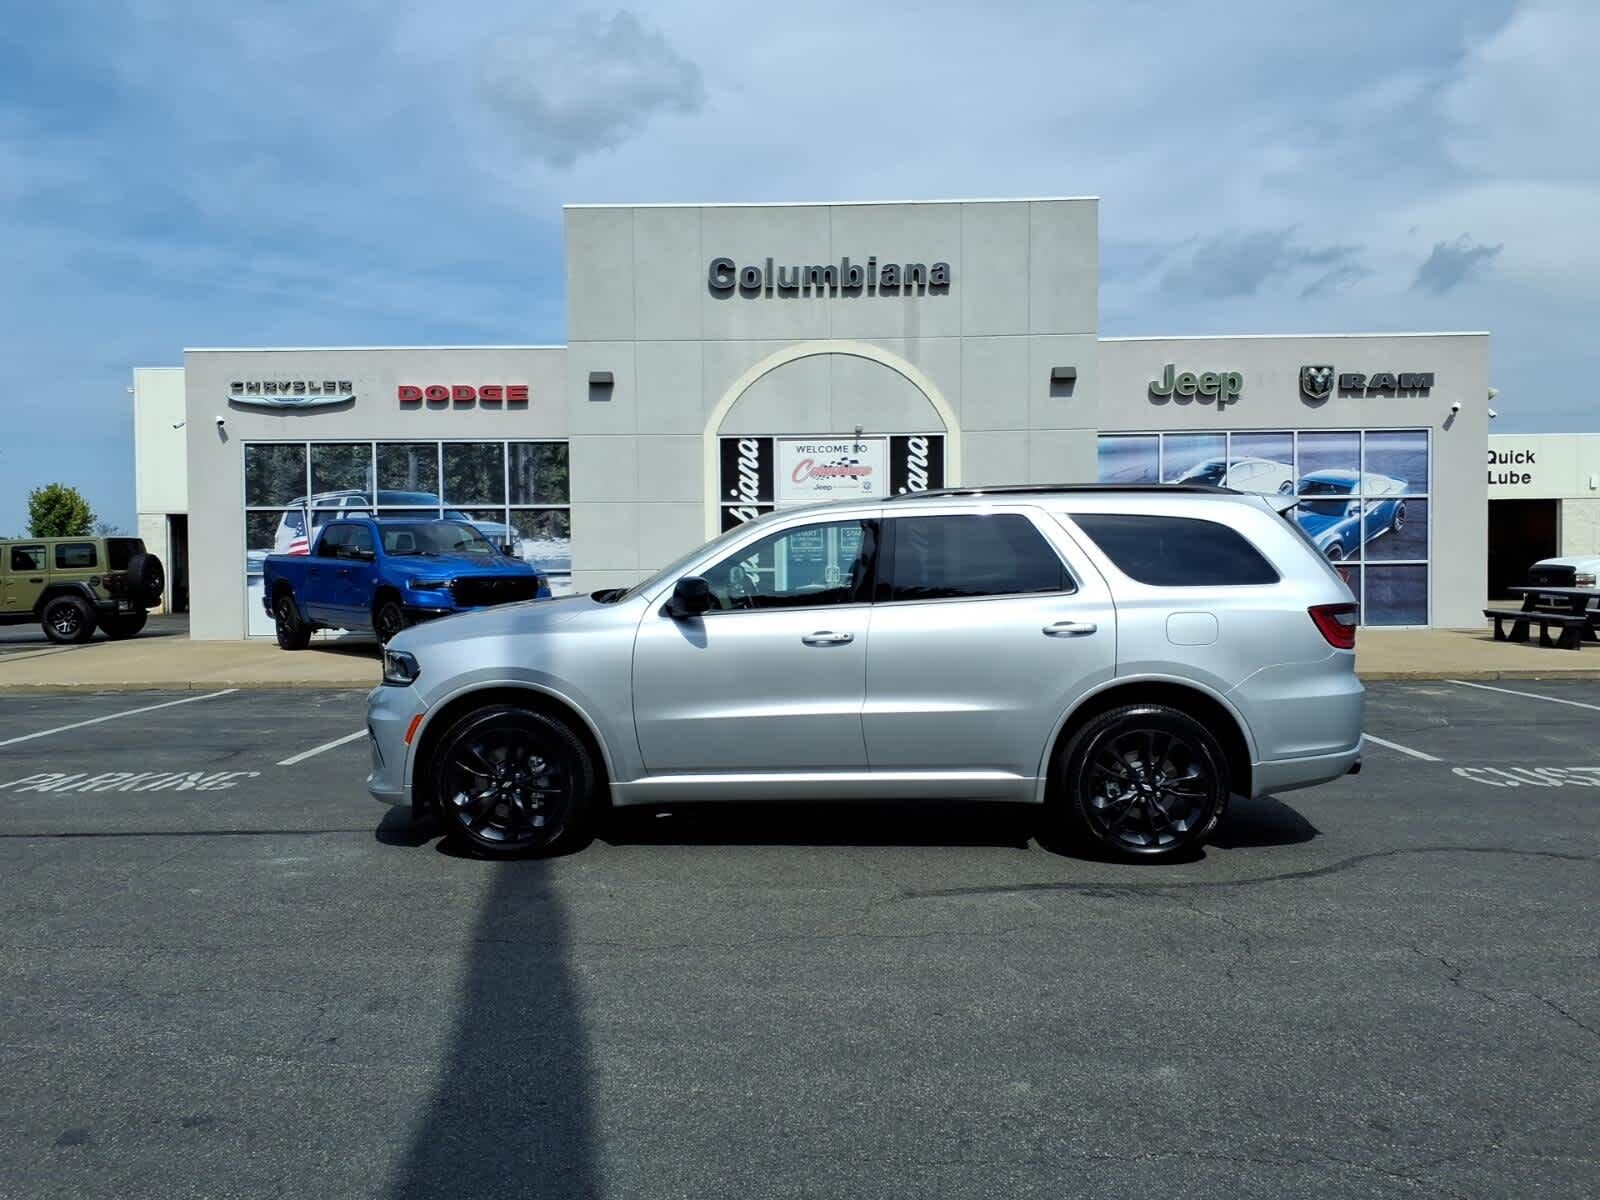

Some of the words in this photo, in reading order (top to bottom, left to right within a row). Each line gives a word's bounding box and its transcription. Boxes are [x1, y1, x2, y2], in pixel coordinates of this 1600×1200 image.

[708, 256, 951, 292] Columbiana
[230, 381, 353, 393] CHRYSLER
[1150, 363, 1244, 401] Jeep
[1339, 372, 1435, 390] RAM
[398, 384, 529, 402] DODGE
[795, 445, 849, 454] WELCOME
[1487, 449, 1536, 465] Quick
[1487, 470, 1532, 485] Lube
